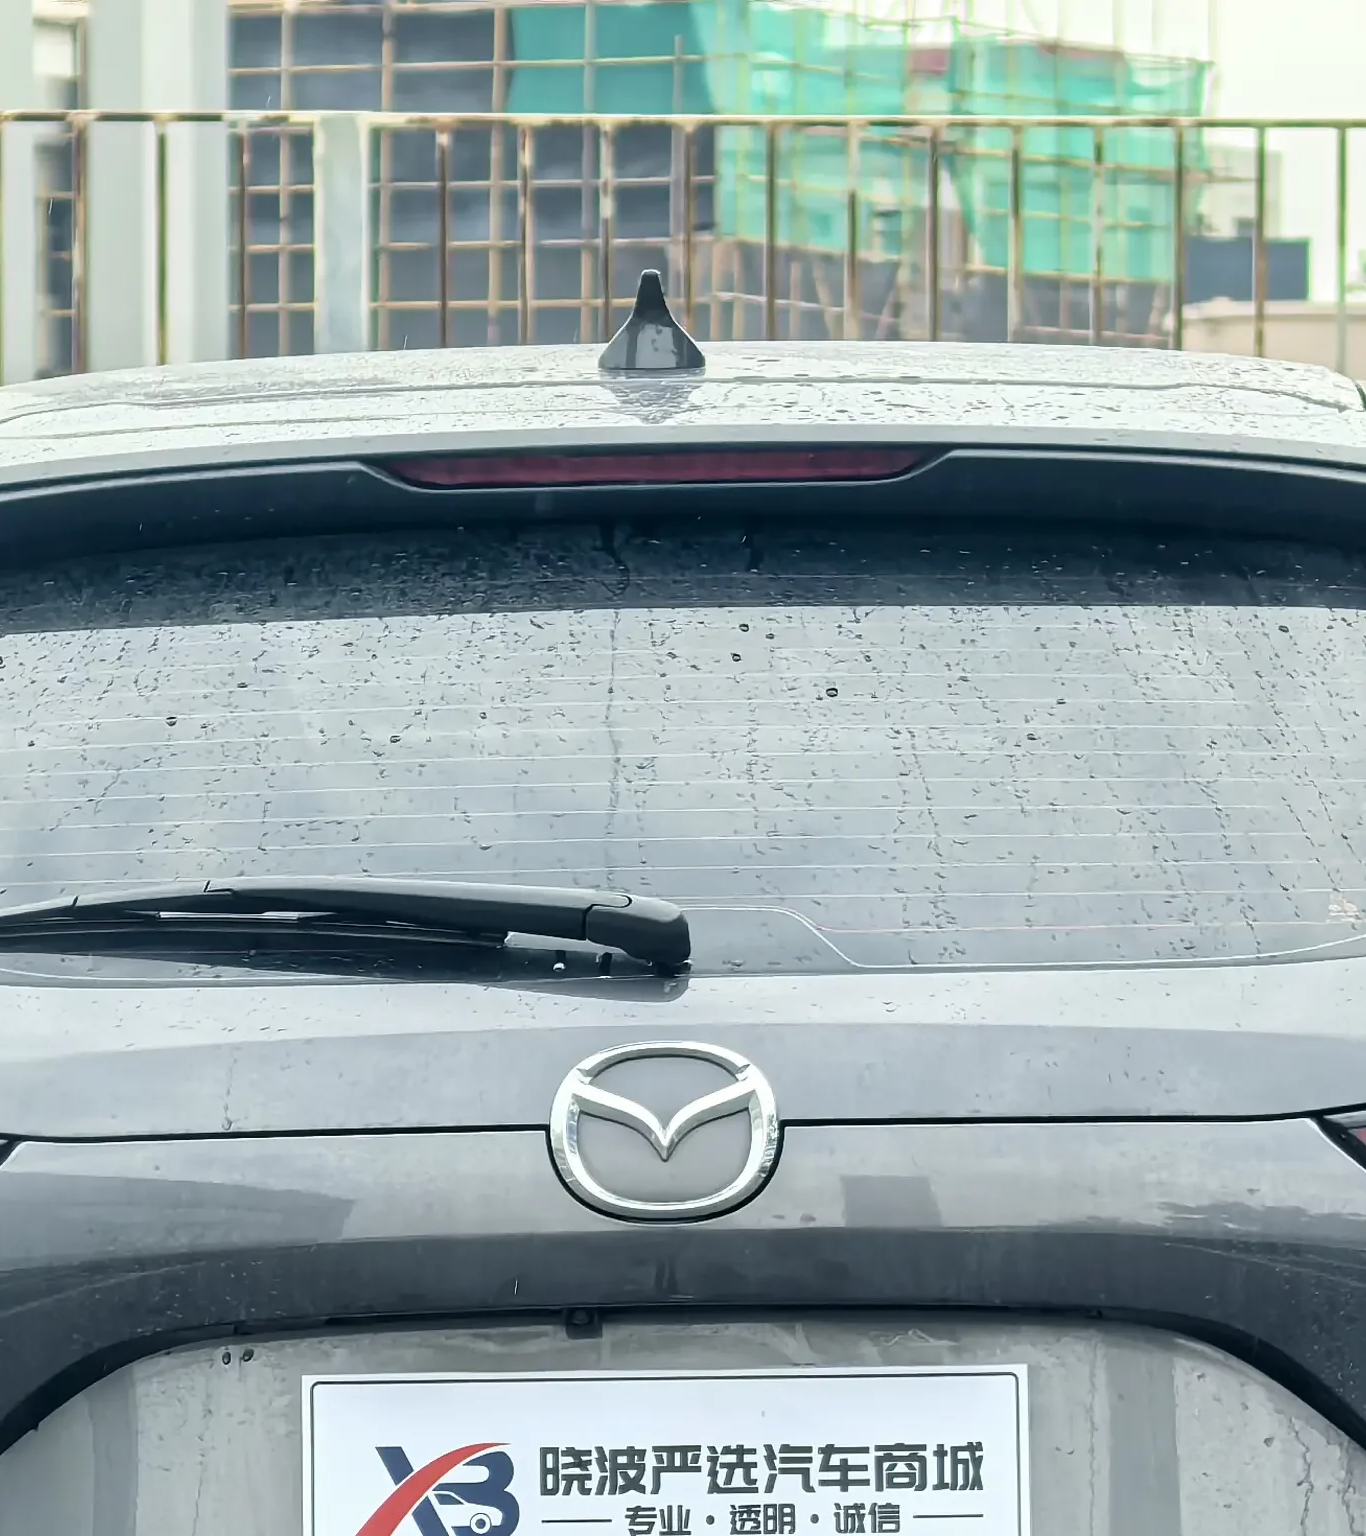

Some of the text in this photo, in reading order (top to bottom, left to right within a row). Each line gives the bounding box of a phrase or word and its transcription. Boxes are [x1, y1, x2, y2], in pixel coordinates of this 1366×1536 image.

[539, 1441, 984, 1496] 晓波严选汽车商城
